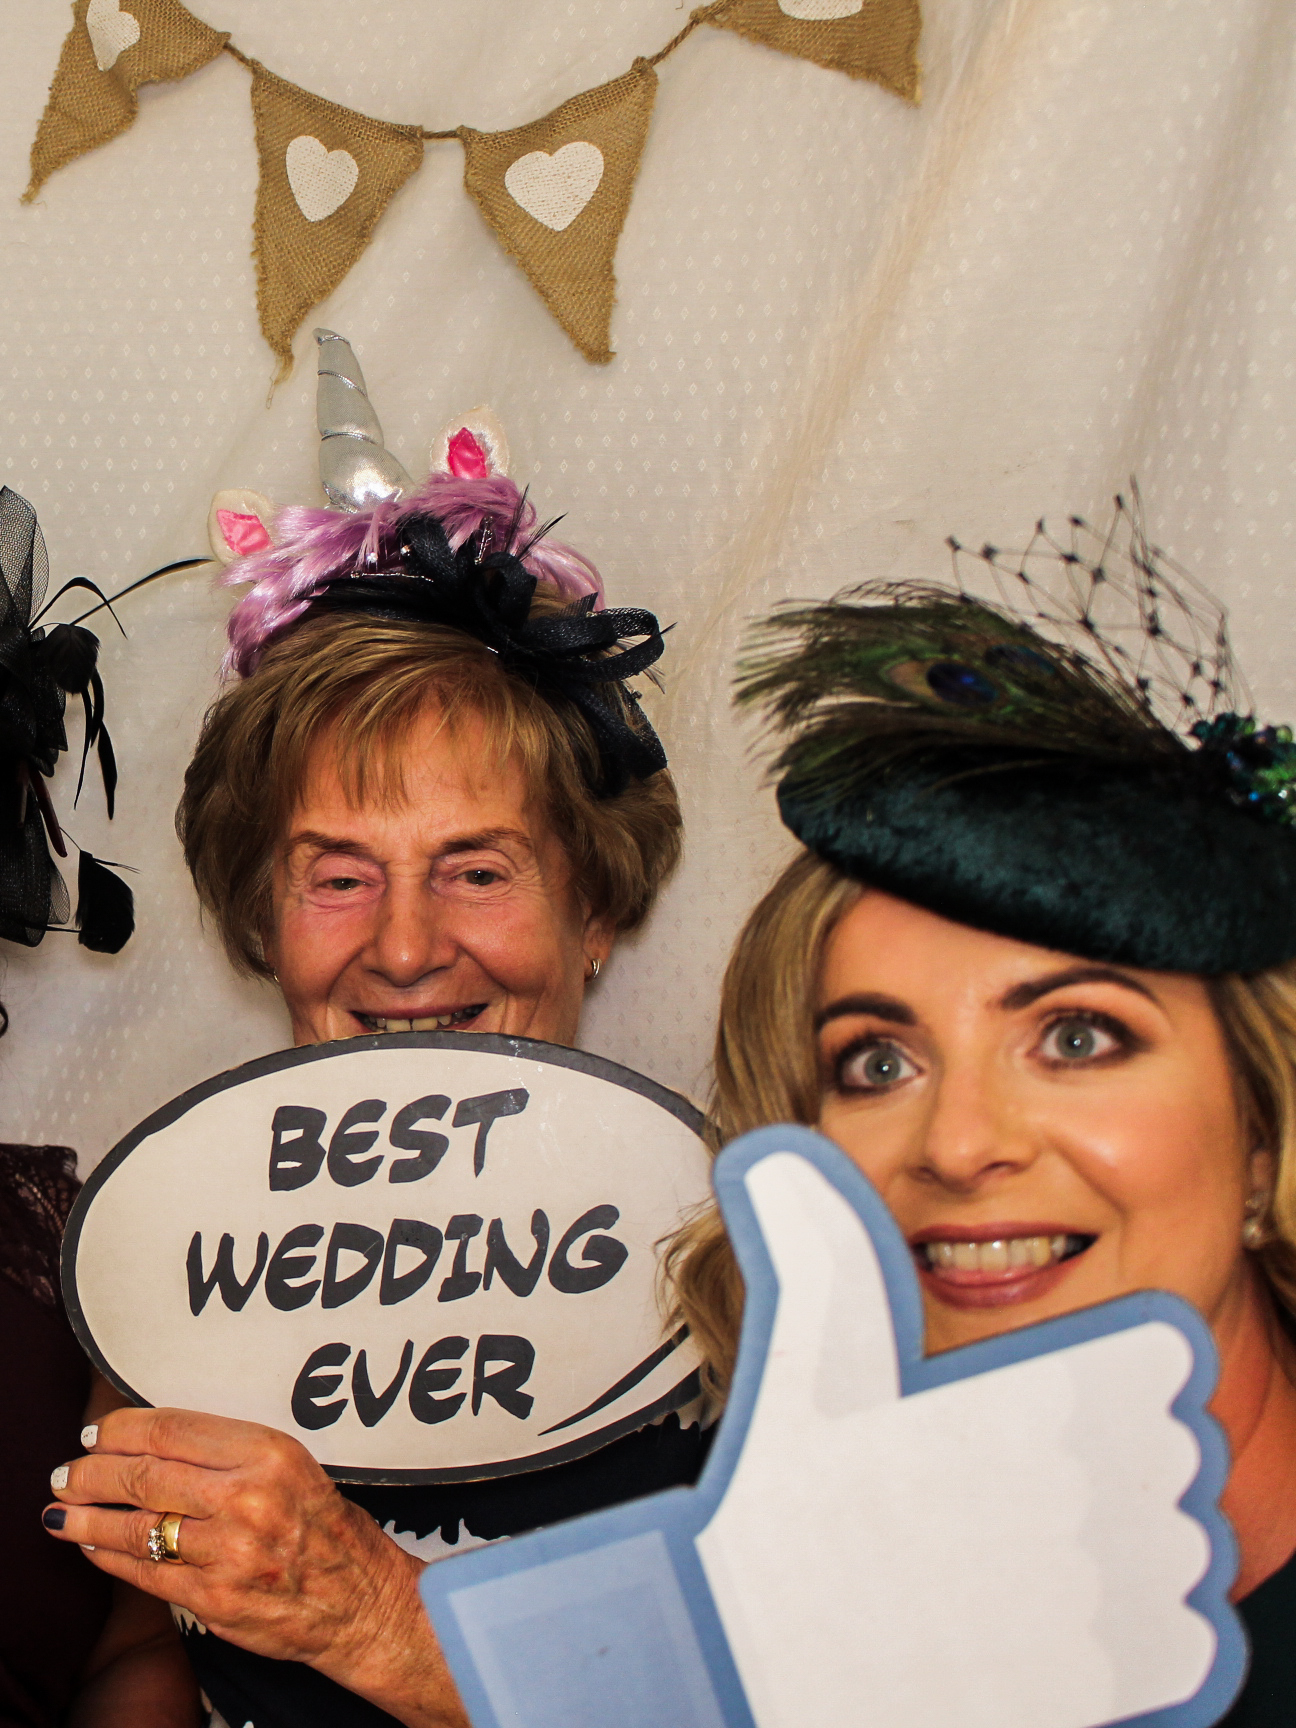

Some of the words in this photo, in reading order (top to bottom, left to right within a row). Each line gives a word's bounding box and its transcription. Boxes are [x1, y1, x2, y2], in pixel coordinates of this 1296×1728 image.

[269, 1088, 530, 1192] BEST
[186, 1204, 629, 1316] WEDDING
[291, 1334, 536, 1430] EVER
